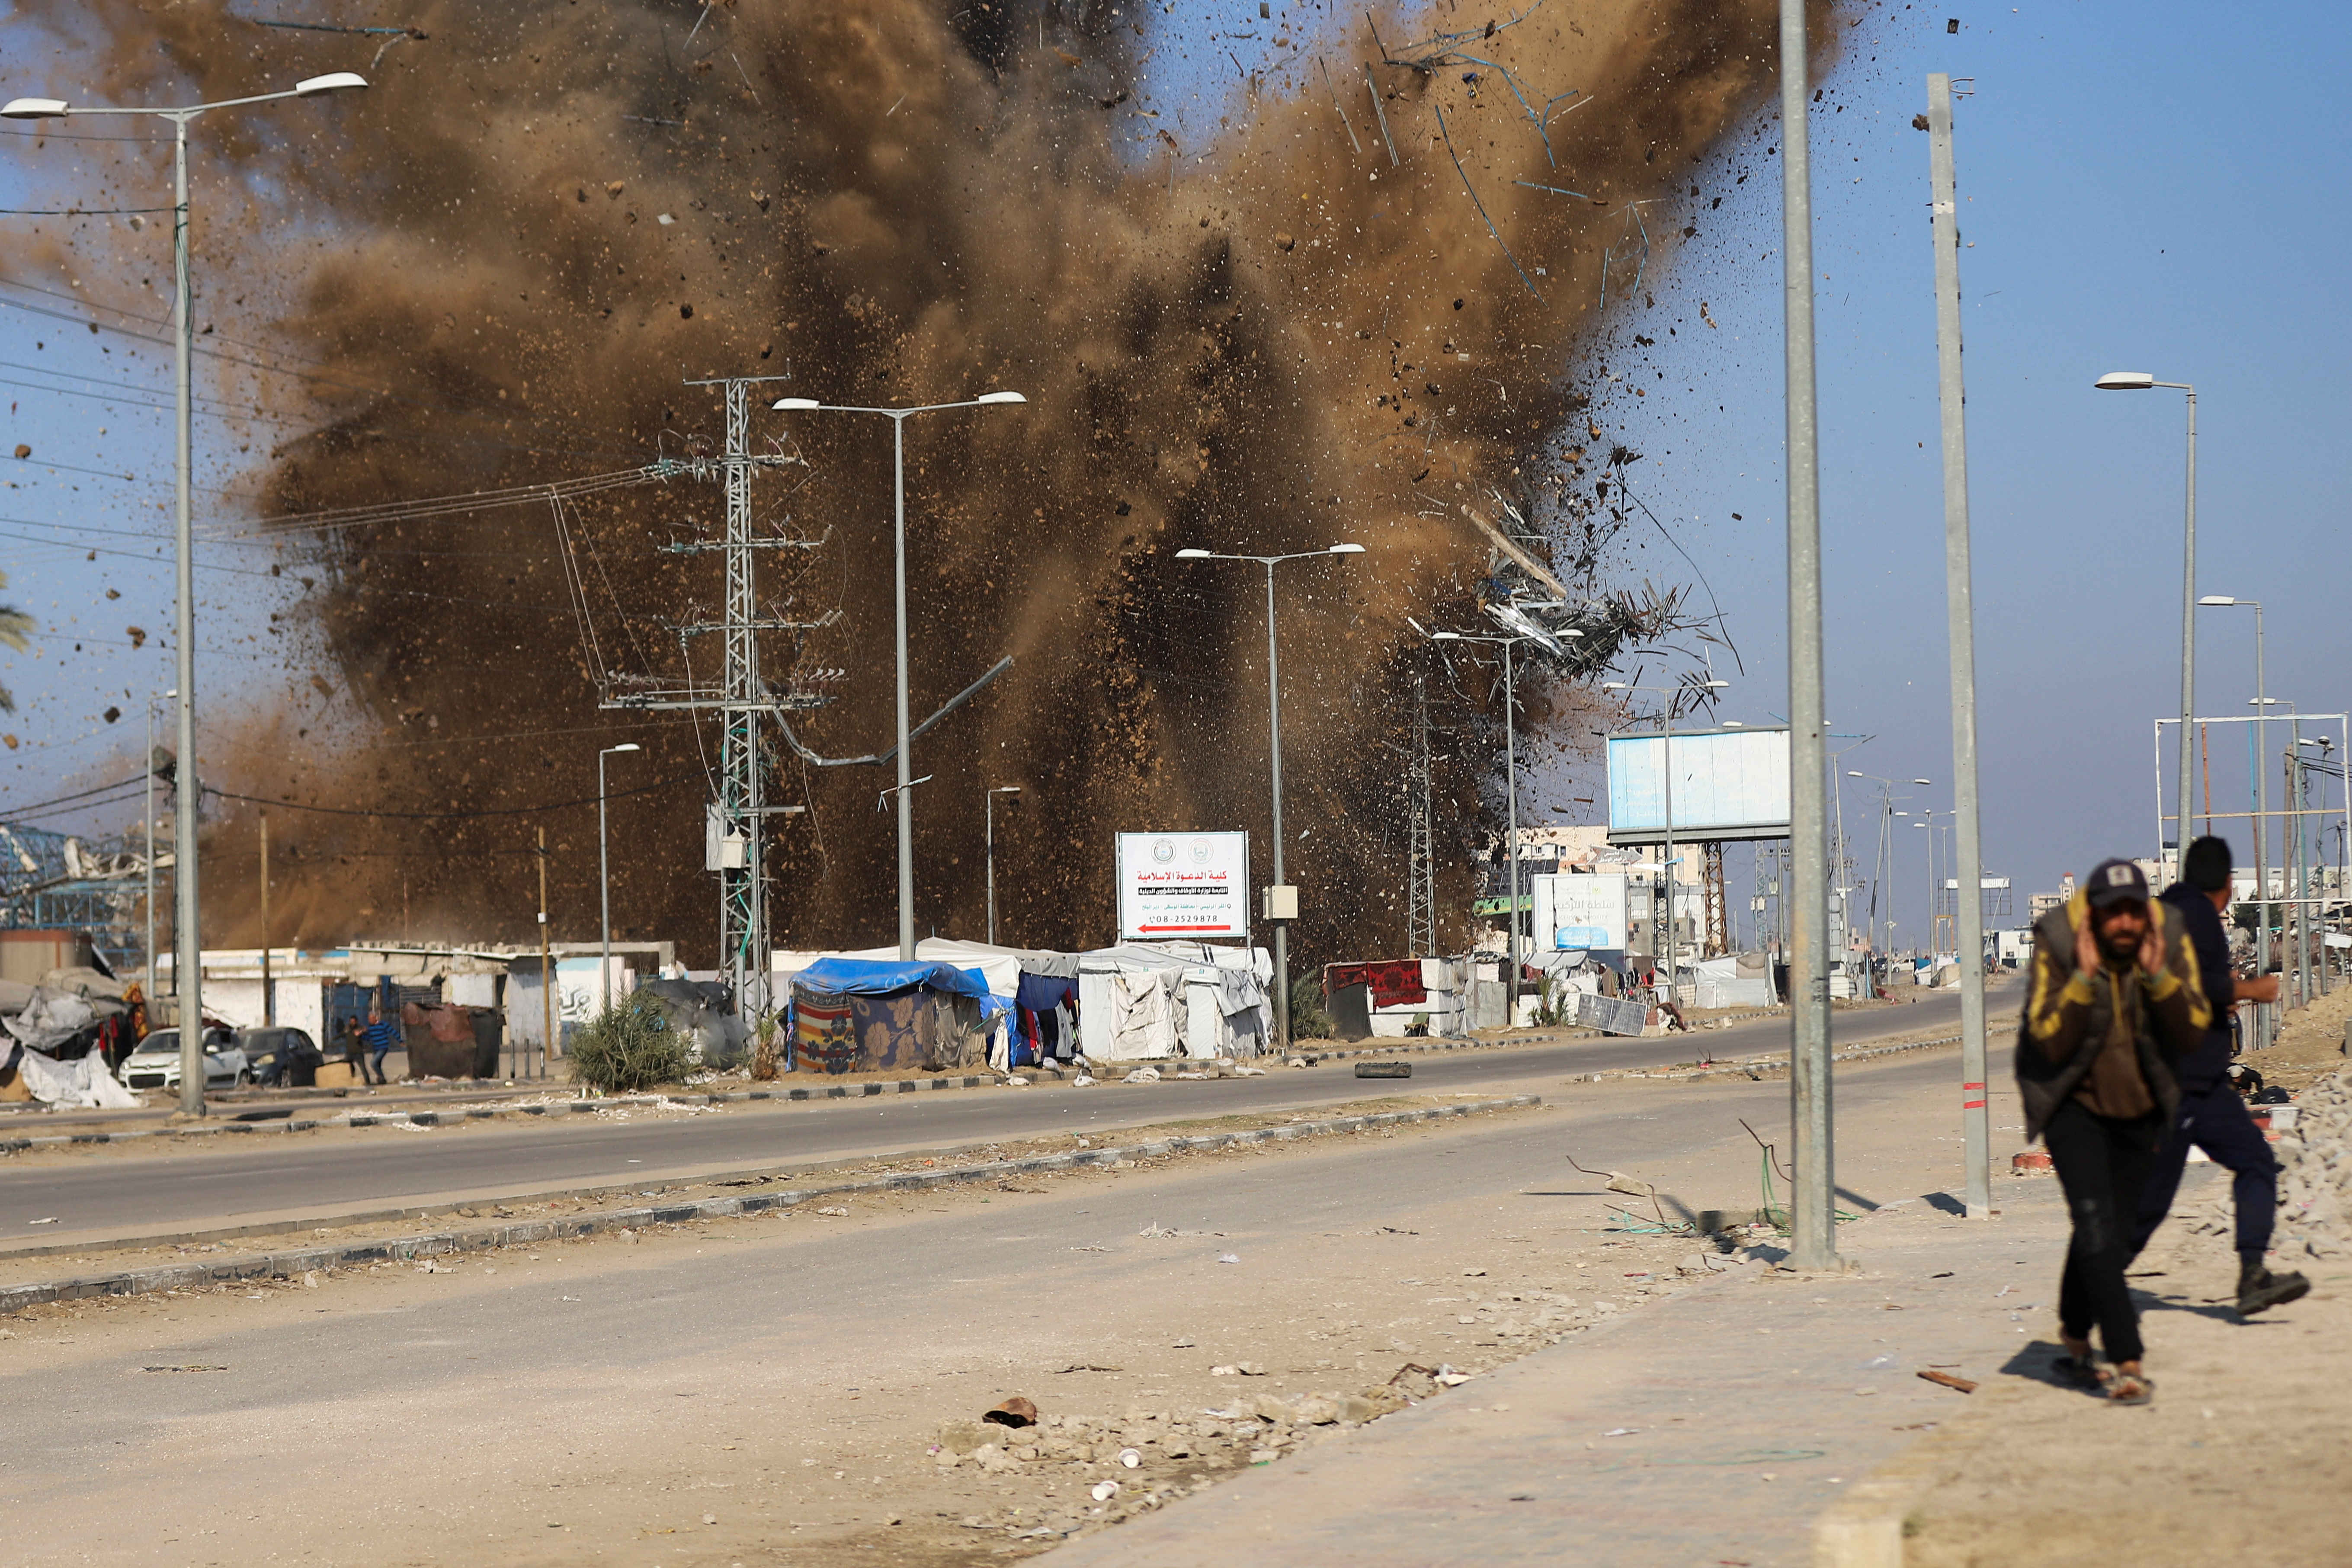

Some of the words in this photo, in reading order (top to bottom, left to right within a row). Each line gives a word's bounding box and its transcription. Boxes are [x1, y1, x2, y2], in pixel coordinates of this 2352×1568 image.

[1137, 871, 1174, 883] الإسلامية
[1176, 871, 1206, 882] الدعوة
[1208, 870, 1227, 882] كلية
[1587, 899, 1615, 909] سلطة
